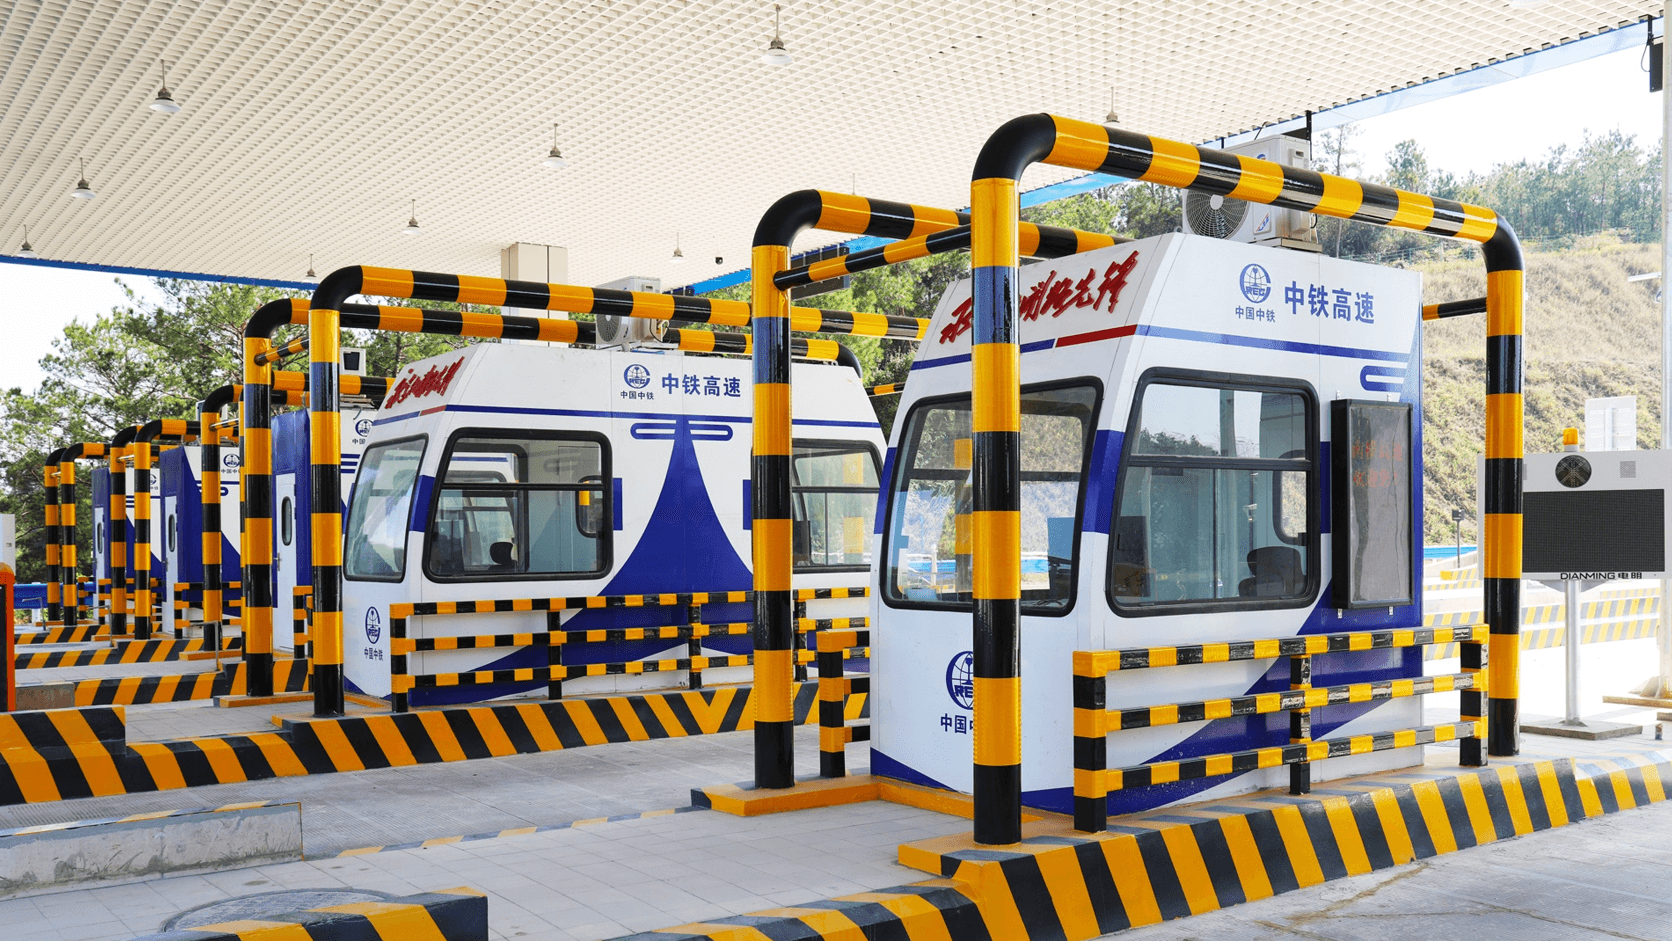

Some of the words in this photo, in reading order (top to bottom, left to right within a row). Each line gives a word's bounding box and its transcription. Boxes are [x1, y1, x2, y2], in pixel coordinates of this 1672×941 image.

[1285, 281, 1374, 324] 中铁高速
[1235, 305, 1275, 323] 中国中铁
[662, 373, 741, 397] 中铁高速
[620, 390, 655, 400] 中国中铁
[1560, 572, 1616, 580] DIANMING
[364, 646, 384, 661] 中国中铁
[940, 713, 973, 734] 中国
